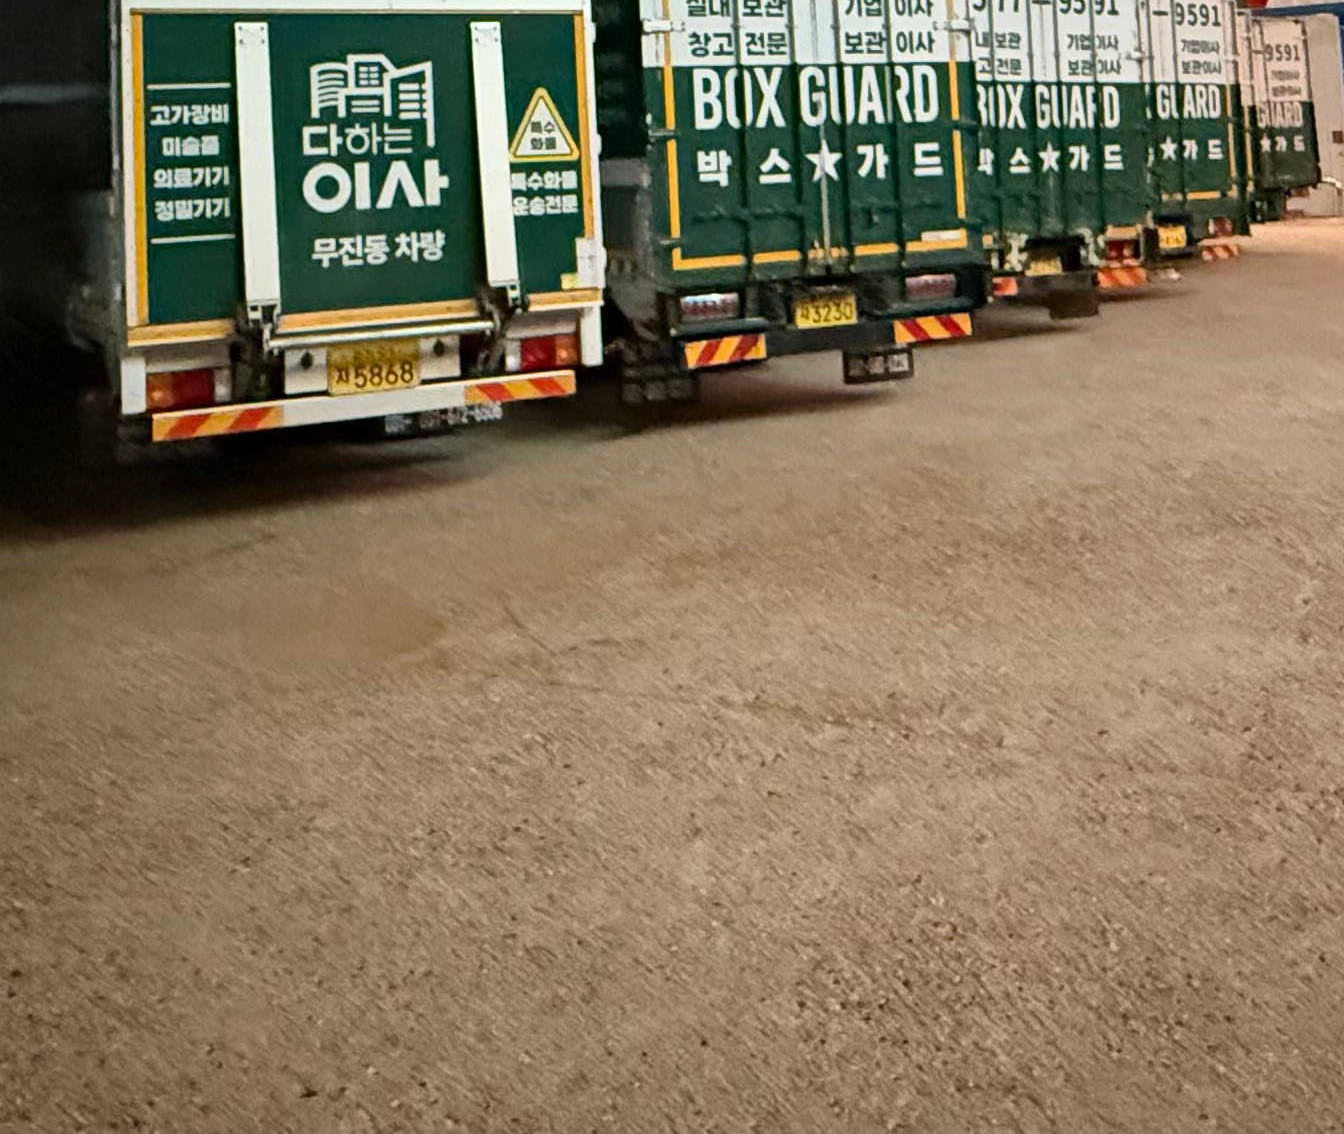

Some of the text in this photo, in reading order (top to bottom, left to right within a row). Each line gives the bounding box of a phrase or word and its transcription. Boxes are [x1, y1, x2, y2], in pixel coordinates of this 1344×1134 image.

[976, 31, 1022, 50] 내보관
[978, 57, 1023, 76] 고전문
[692, 63, 940, 131] BOX GUARD
[150, 103, 231, 126] 고가장비
[302, 122, 414, 157] 다하는
[153, 165, 231, 189] 의료기기
[302, 159, 450, 214] 이사
[154, 197, 232, 222] 정밀기기
[311, 229, 447, 269] 무진동 차량
